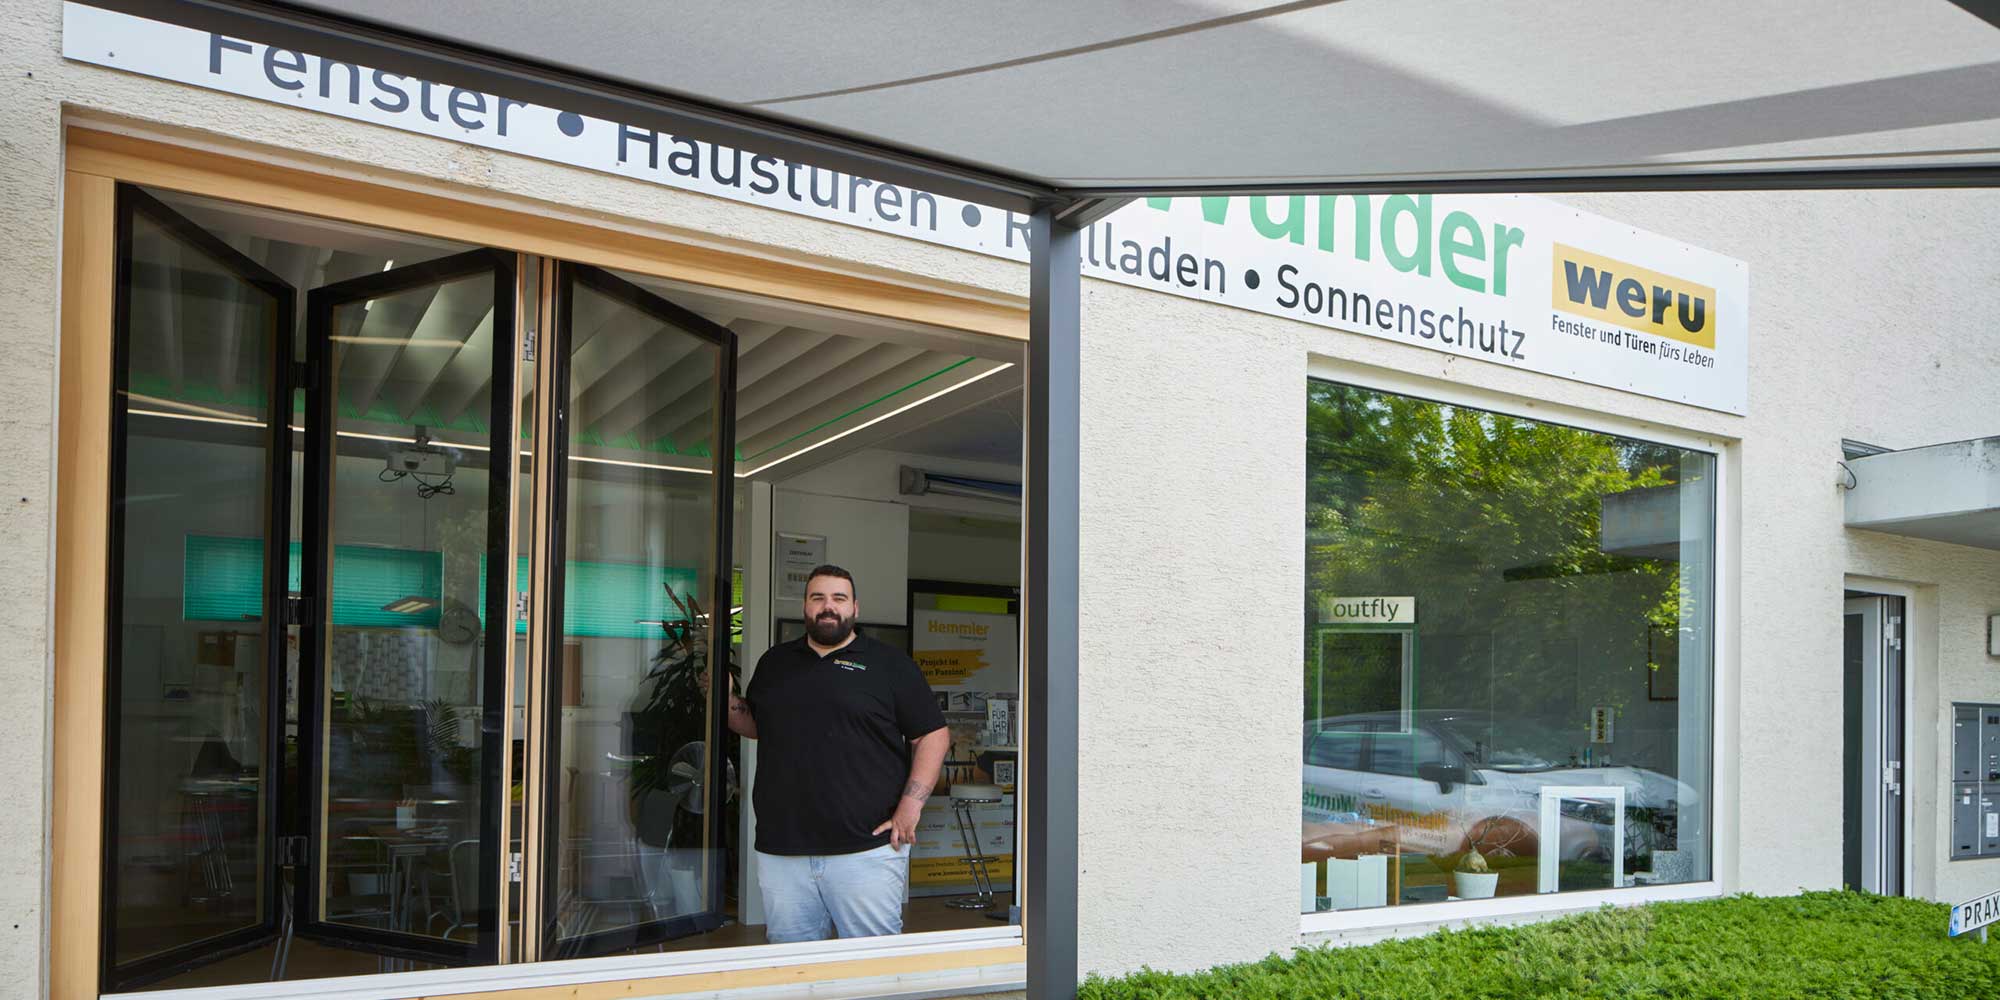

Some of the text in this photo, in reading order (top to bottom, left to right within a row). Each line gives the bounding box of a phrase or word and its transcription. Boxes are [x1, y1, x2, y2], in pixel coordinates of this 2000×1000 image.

[208, 33, 528, 137] Fenster
[1006, 211, 1226, 294] Rlladen
[1276, 264, 1526, 360] Sonnenschutz
[1146, 194, 1525, 297] under
[1563, 260, 1705, 333] weru
[1552, 314, 1714, 369] Fenster und Türen fürs Leben
[928, 619, 990, 636] Hemmler
[1333, 598, 1399, 622] outfly
[1964, 895, 2000, 928] PRAX
